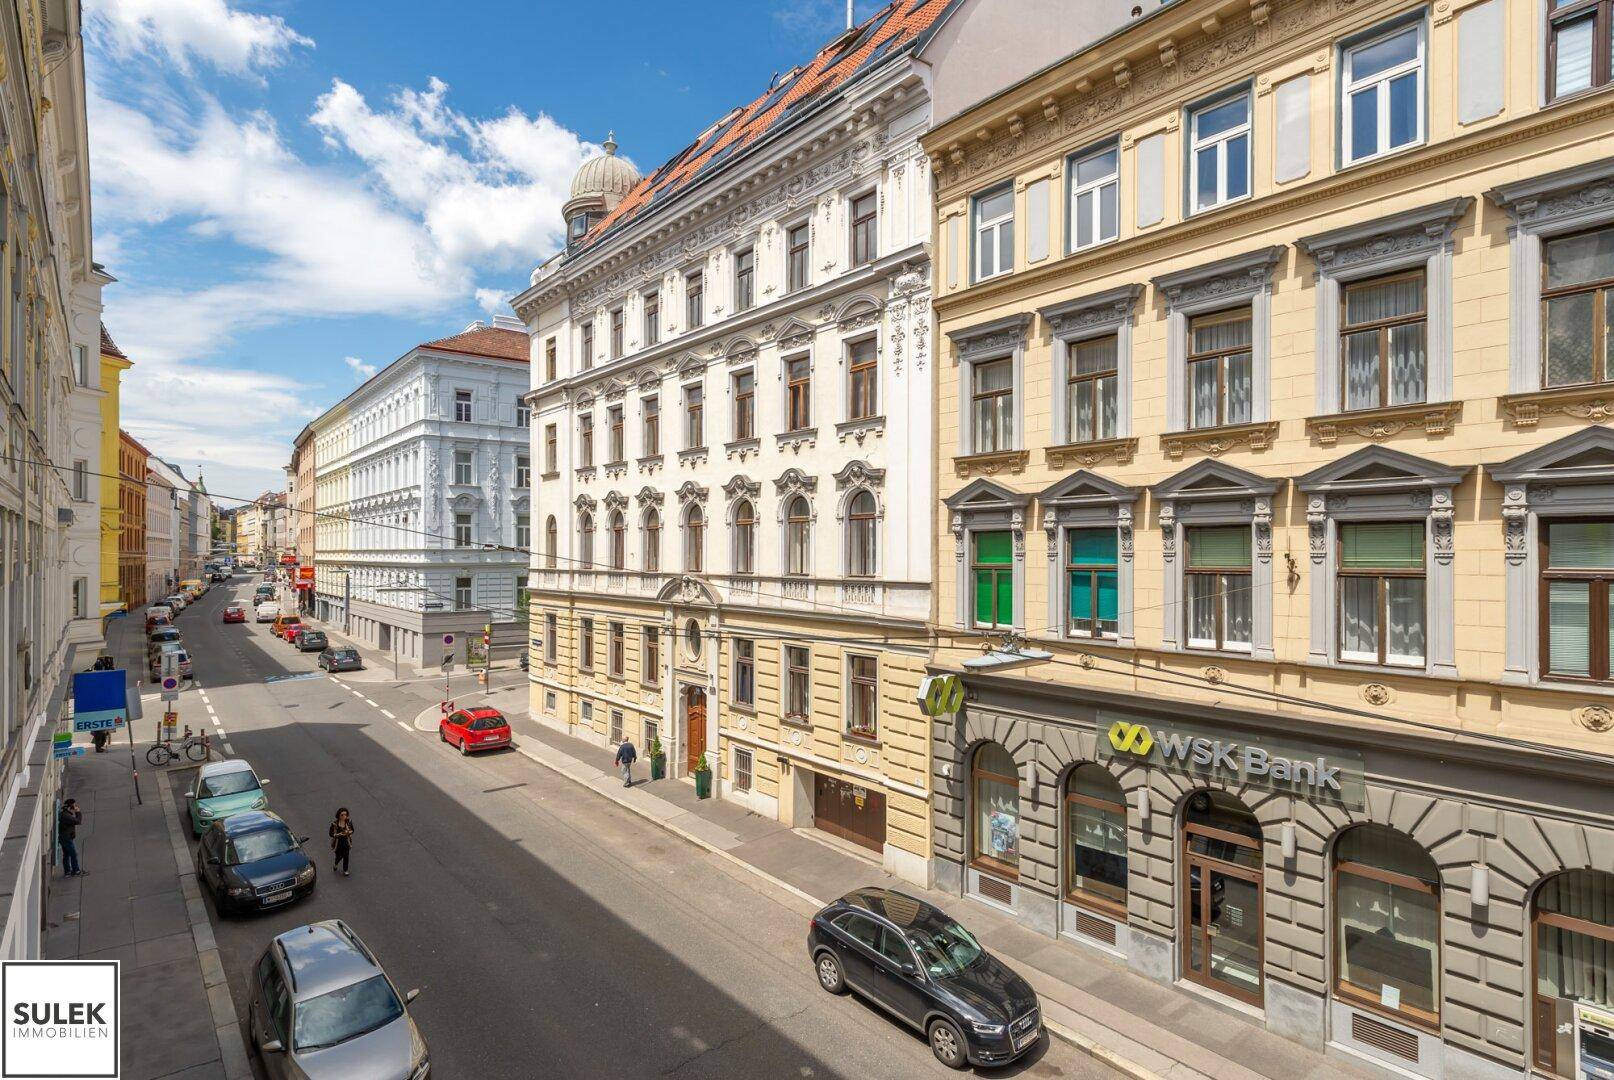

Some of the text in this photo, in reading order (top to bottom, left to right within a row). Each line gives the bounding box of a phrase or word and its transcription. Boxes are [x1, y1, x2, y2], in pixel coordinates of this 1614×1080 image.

[76, 719, 113, 730] ERSTE
[1156, 731, 1342, 790] WSK Bank
